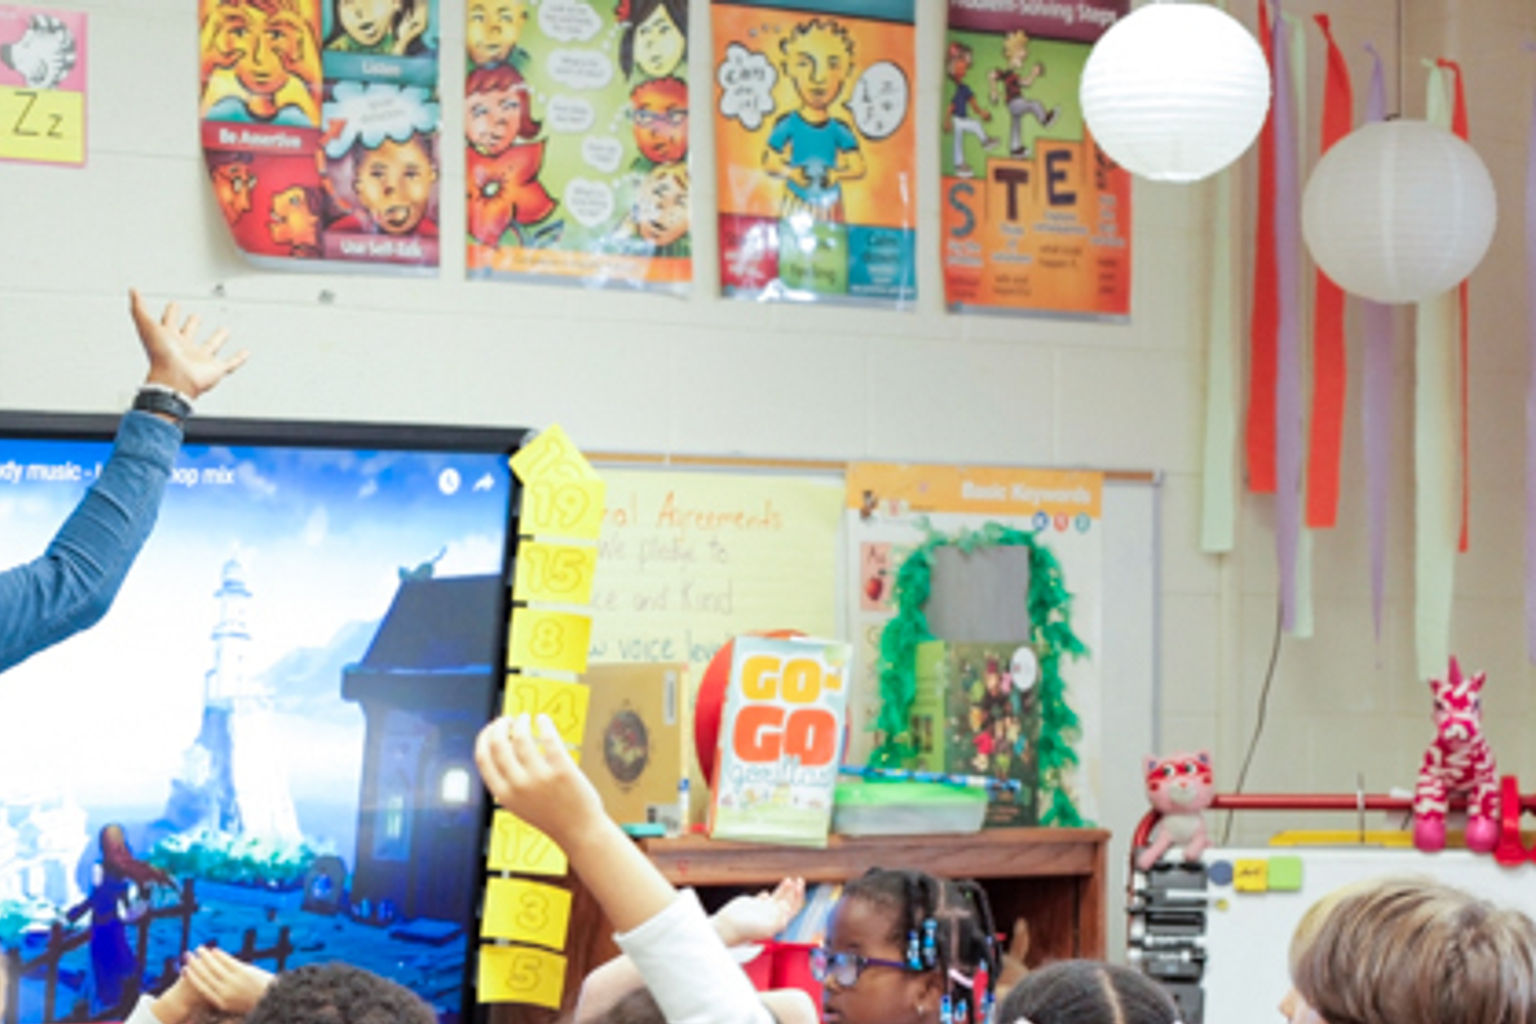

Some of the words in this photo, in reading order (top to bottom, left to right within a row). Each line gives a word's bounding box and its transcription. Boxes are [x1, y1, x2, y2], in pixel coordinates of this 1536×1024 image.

[12, 91, 64, 139] Zz
[26, 462, 82, 482] music
[203, 466, 236, 485] mix
[531, 480, 591, 529] 19
[524, 546, 587, 594] 15
[530, 618, 564, 659] 8
[733, 704, 837, 766] GO
